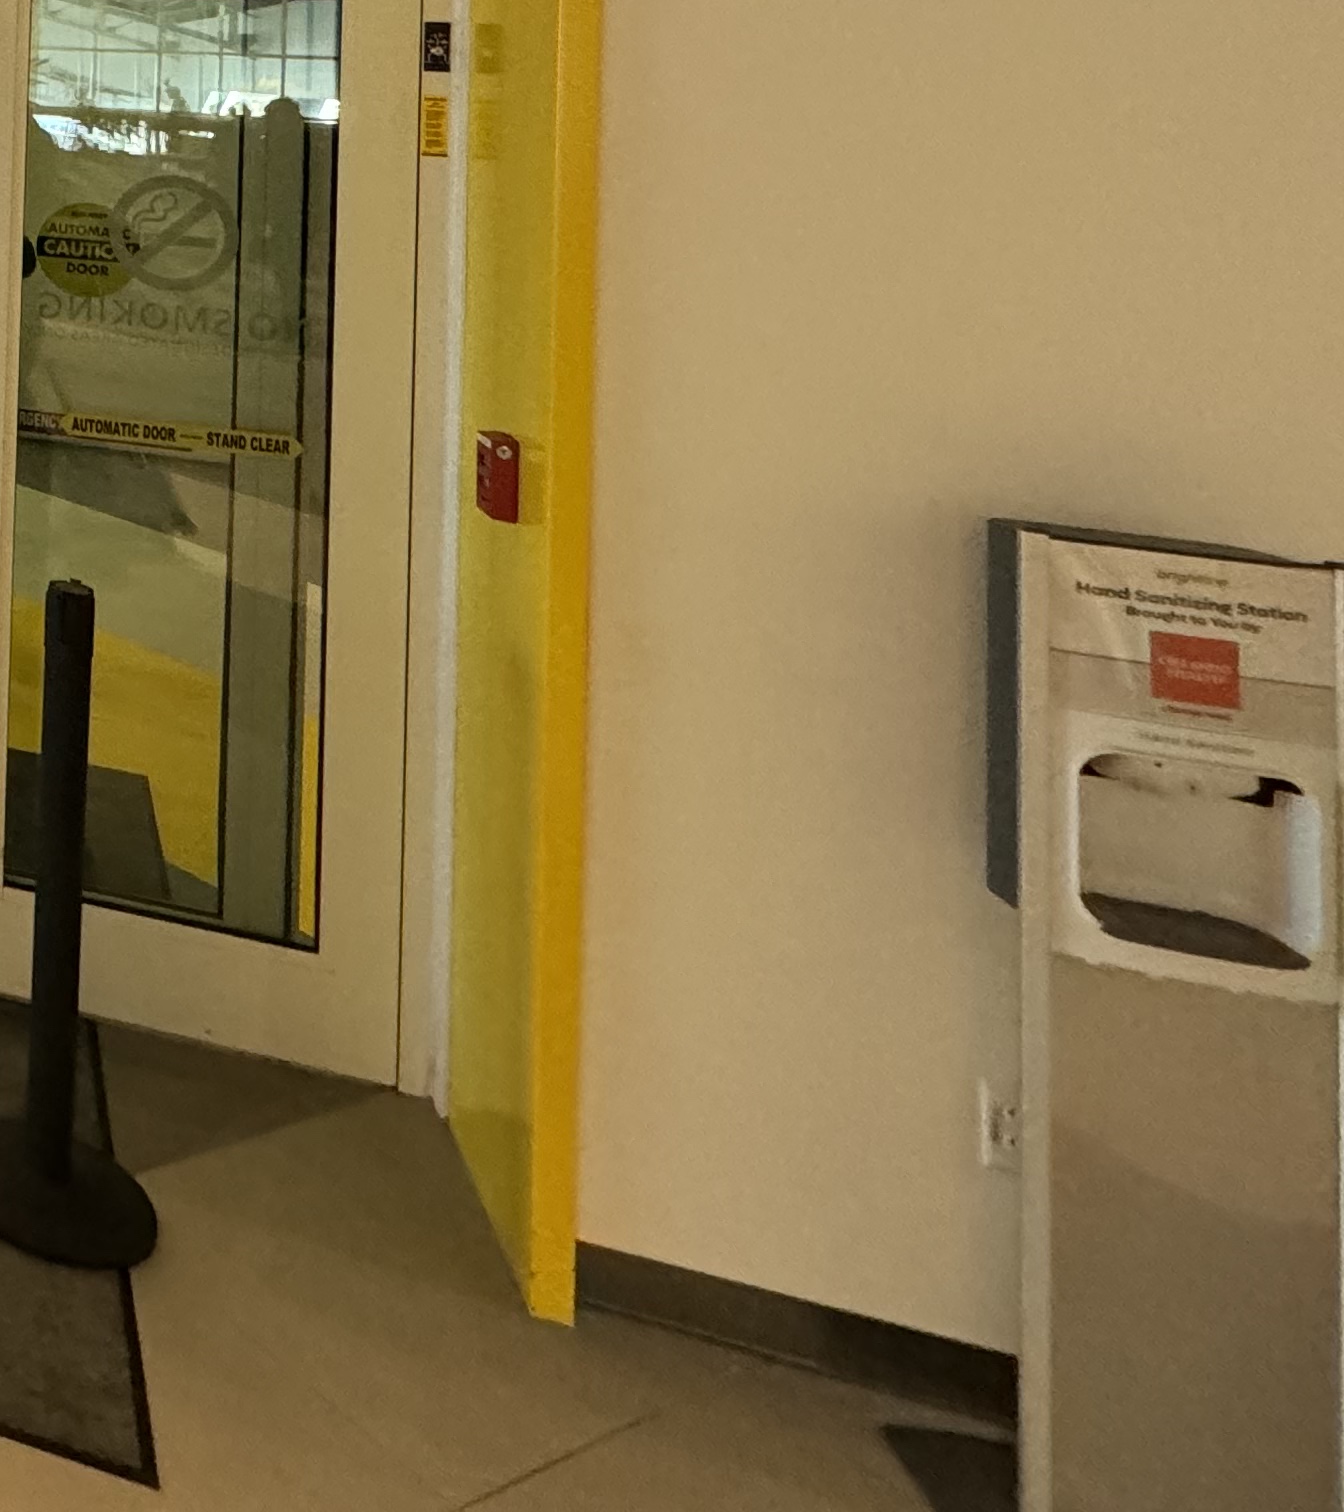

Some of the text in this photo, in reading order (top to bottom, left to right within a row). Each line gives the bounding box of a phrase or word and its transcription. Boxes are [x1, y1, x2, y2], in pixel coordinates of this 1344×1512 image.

[66, 262, 109, 276] DOOR
[71, 417, 139, 438] AUTOMATIC
[143, 425, 176, 442] DOOR
[206, 433, 247, 450] STAND
[250, 437, 290, 455] CLEAR
[1076, 581, 1309, 624] Hand Sanitizing Station
[1126, 605, 1187, 625] Brought
[1192, 613, 1206, 626] to
